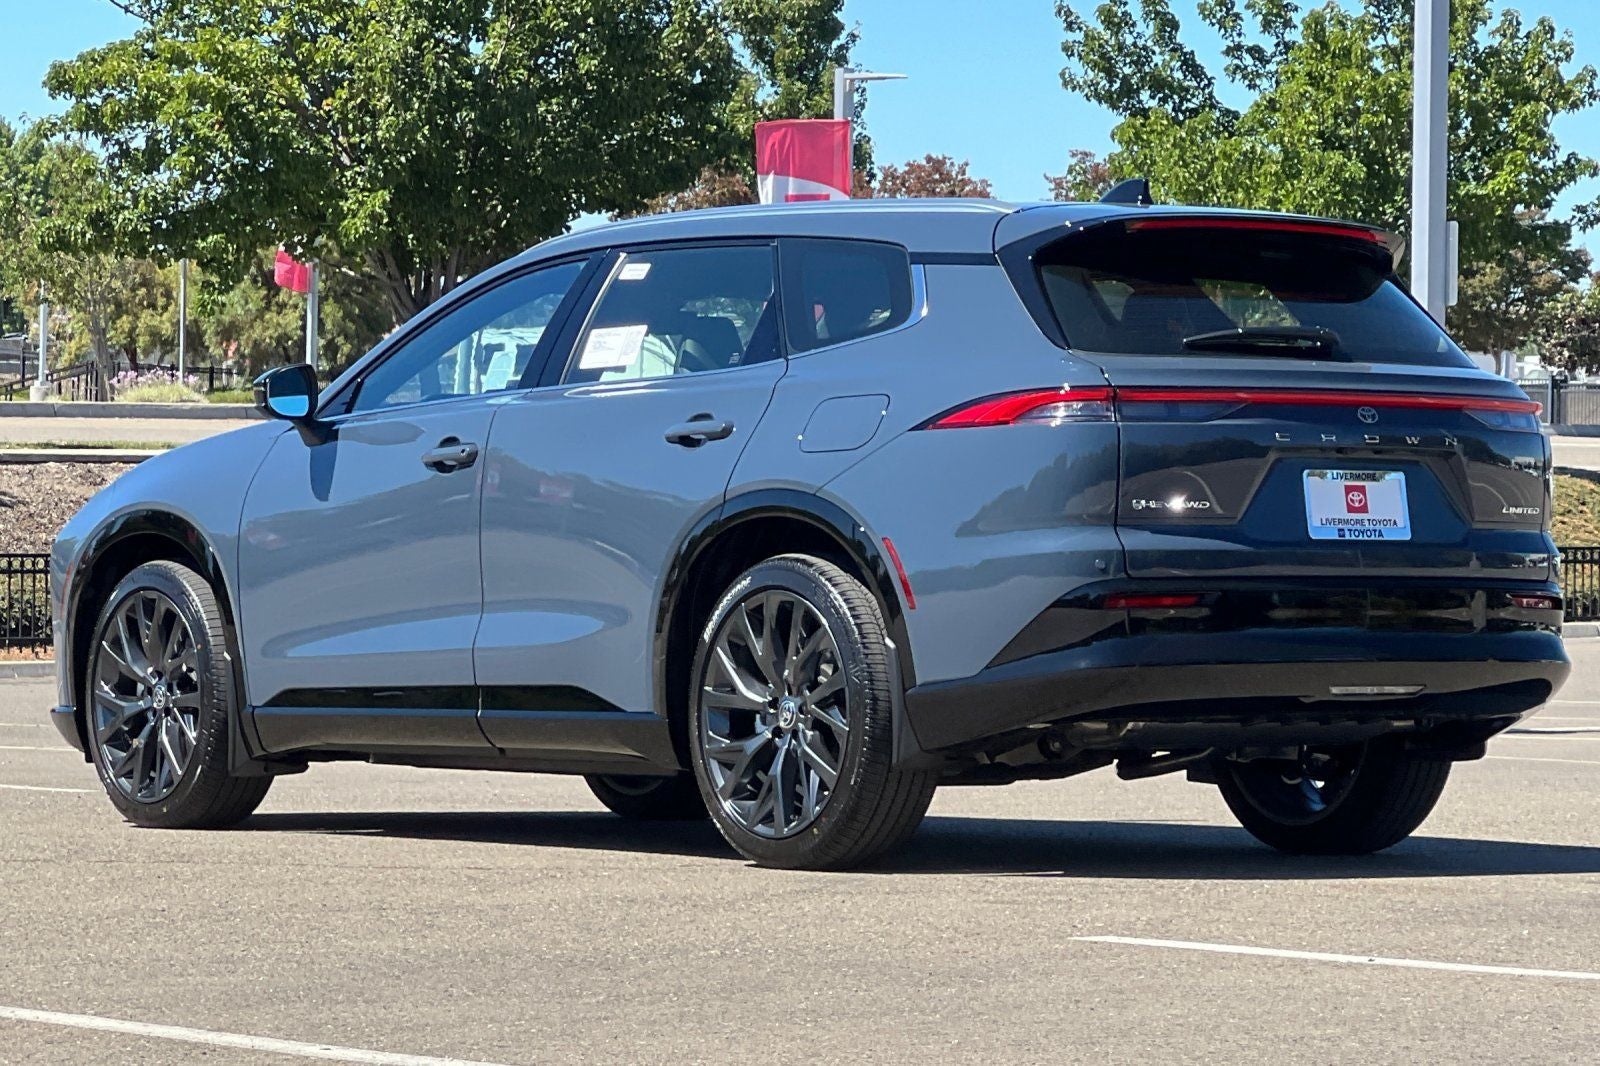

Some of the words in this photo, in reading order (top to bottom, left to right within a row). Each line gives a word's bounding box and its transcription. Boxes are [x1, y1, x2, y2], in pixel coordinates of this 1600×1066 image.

[1331, 471, 1378, 481] LIVERMORE
[1501, 506, 1540, 515] LIMITED
[1320, 517, 1367, 527] LIVERMORE
[1367, 518, 1399, 528] TOYOTA
[1347, 528, 1385, 539] TOYOTA
